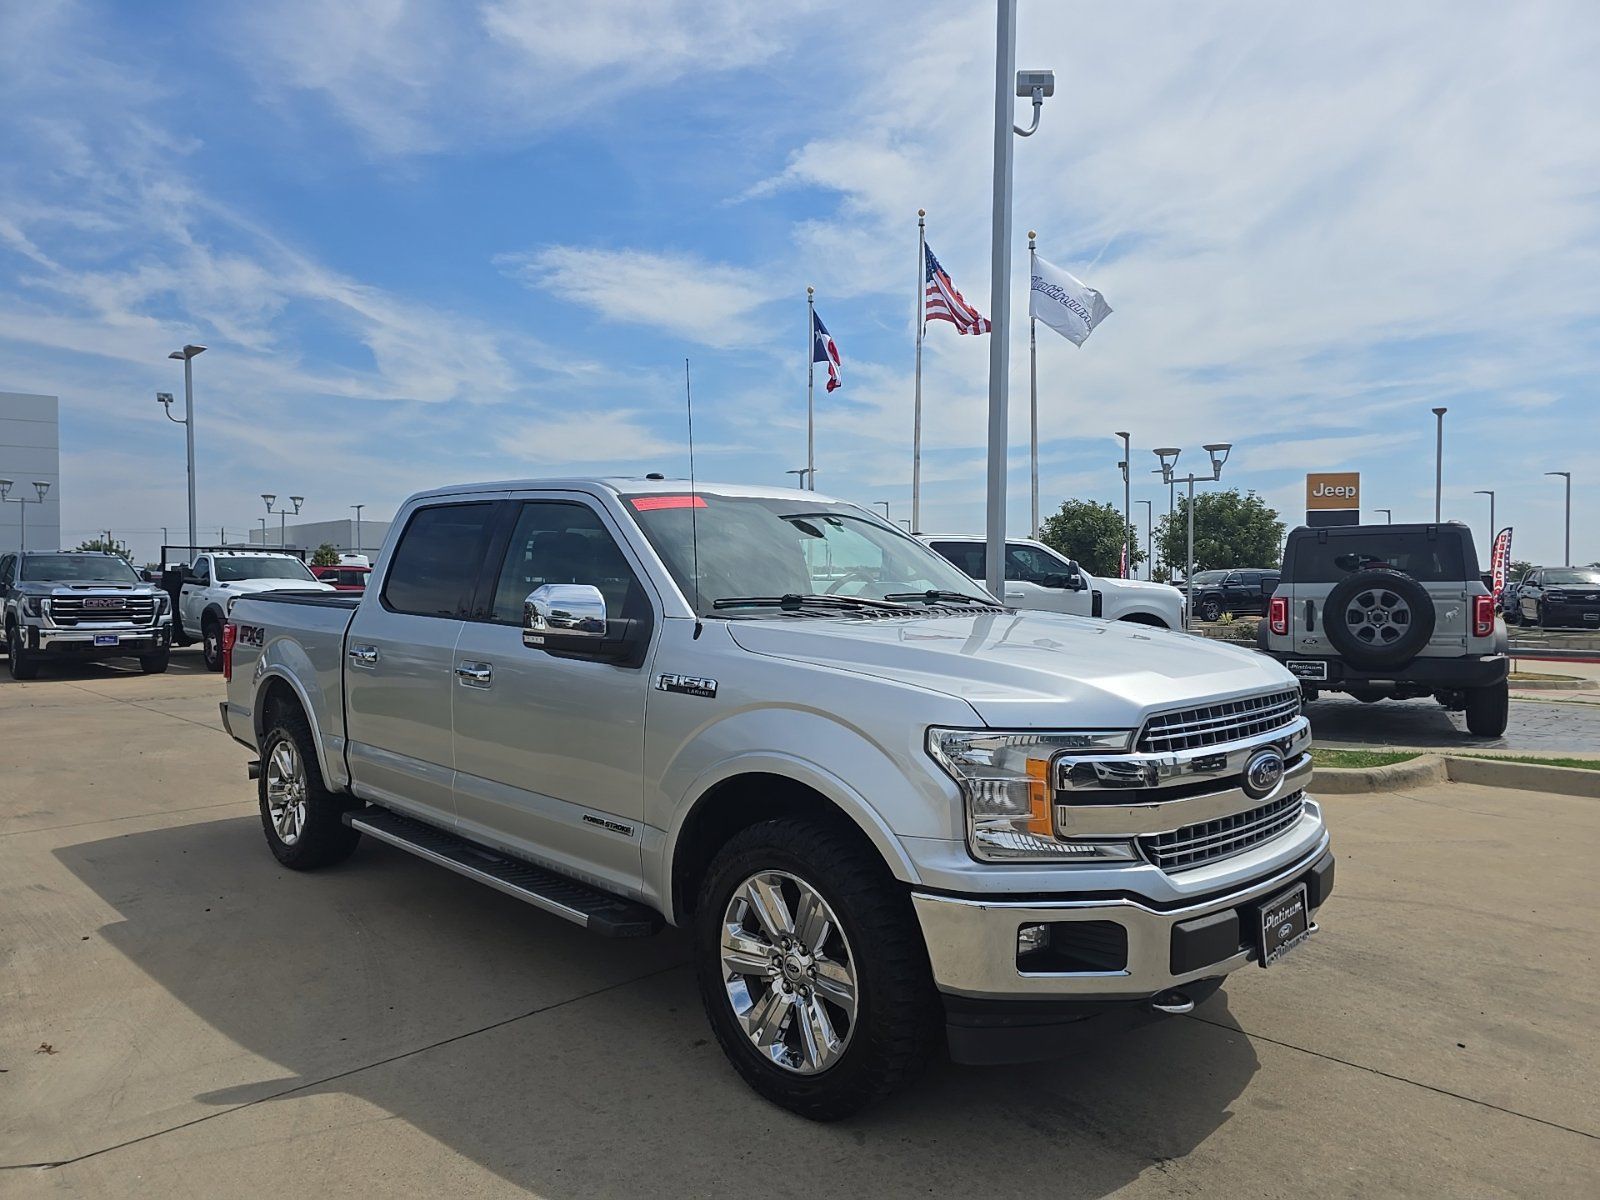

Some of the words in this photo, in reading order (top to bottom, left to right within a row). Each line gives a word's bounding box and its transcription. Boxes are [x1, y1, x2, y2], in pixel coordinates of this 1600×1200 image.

[1312, 482, 1356, 499] Jeep
[86, 599, 124, 607] GMC
[240, 626, 264, 643] FX4
[1259, 761, 1279, 783] Ford
[583, 814, 605, 826] POWER
[605, 821, 631, 833] STROKE
[1264, 902, 1303, 931] Platinum
